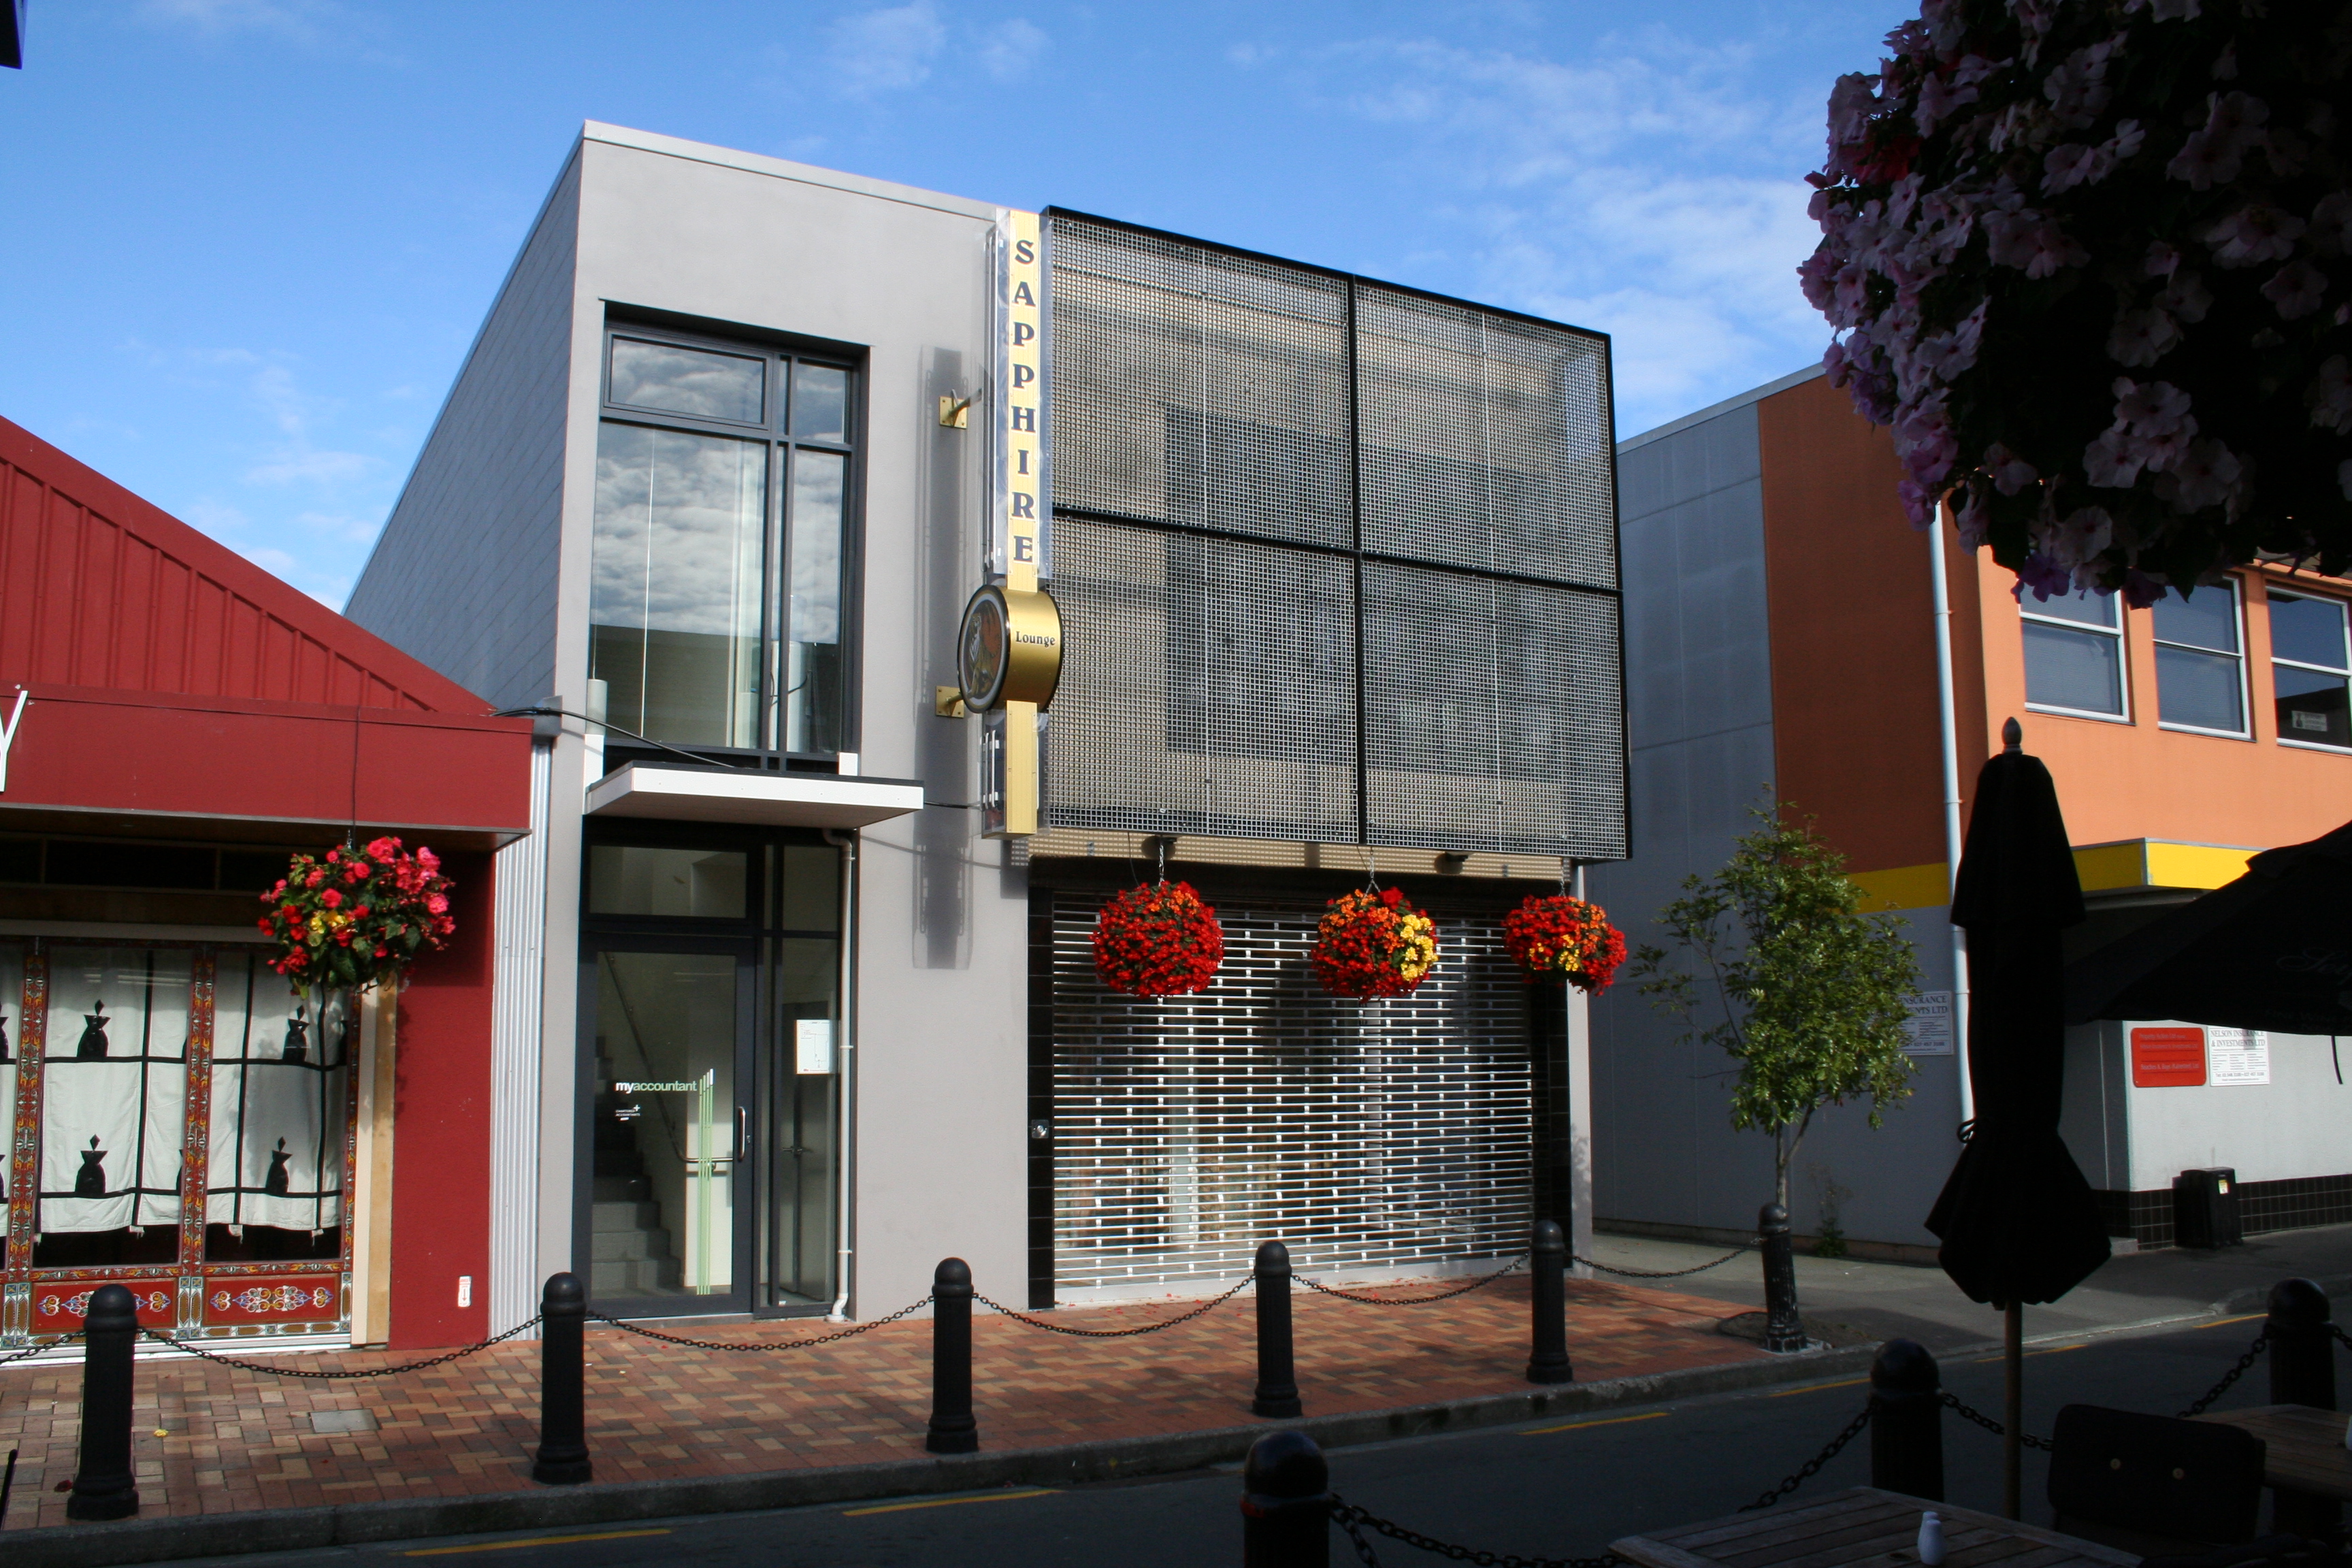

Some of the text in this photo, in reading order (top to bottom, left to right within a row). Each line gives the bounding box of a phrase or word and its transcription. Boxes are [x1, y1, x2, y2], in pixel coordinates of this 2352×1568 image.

[1011, 240, 1036, 563] SAPPHIRE
[1015, 631, 1056, 647] Lounge
[615, 1080, 697, 1094] myaccountant
